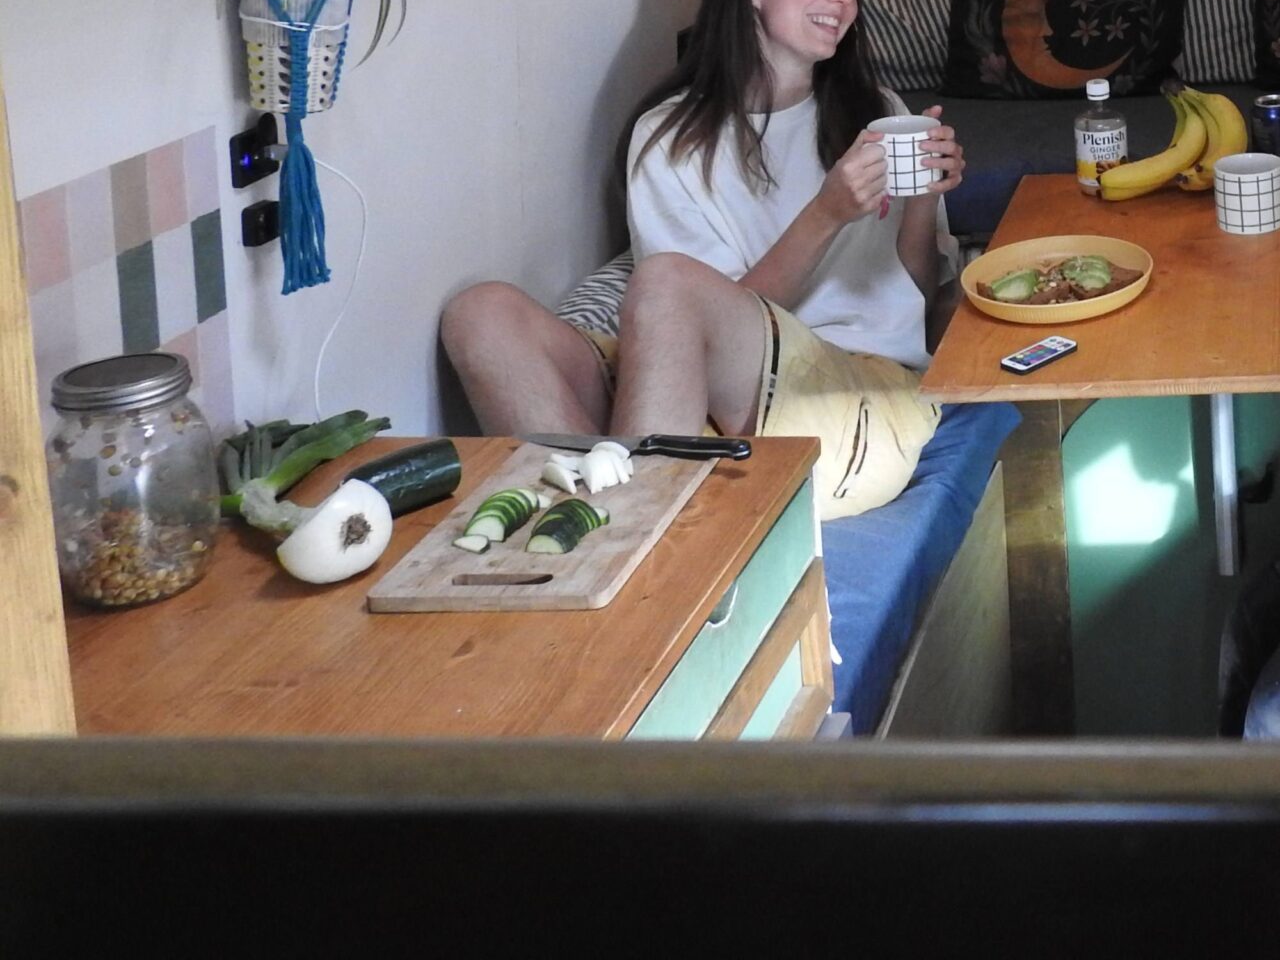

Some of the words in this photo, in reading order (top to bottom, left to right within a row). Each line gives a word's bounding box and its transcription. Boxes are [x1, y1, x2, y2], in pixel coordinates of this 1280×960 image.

[1083, 131, 1125, 145] Plenish
[1090, 144, 1120, 153] GINGER
[1093, 152, 1119, 161] SHOTS
